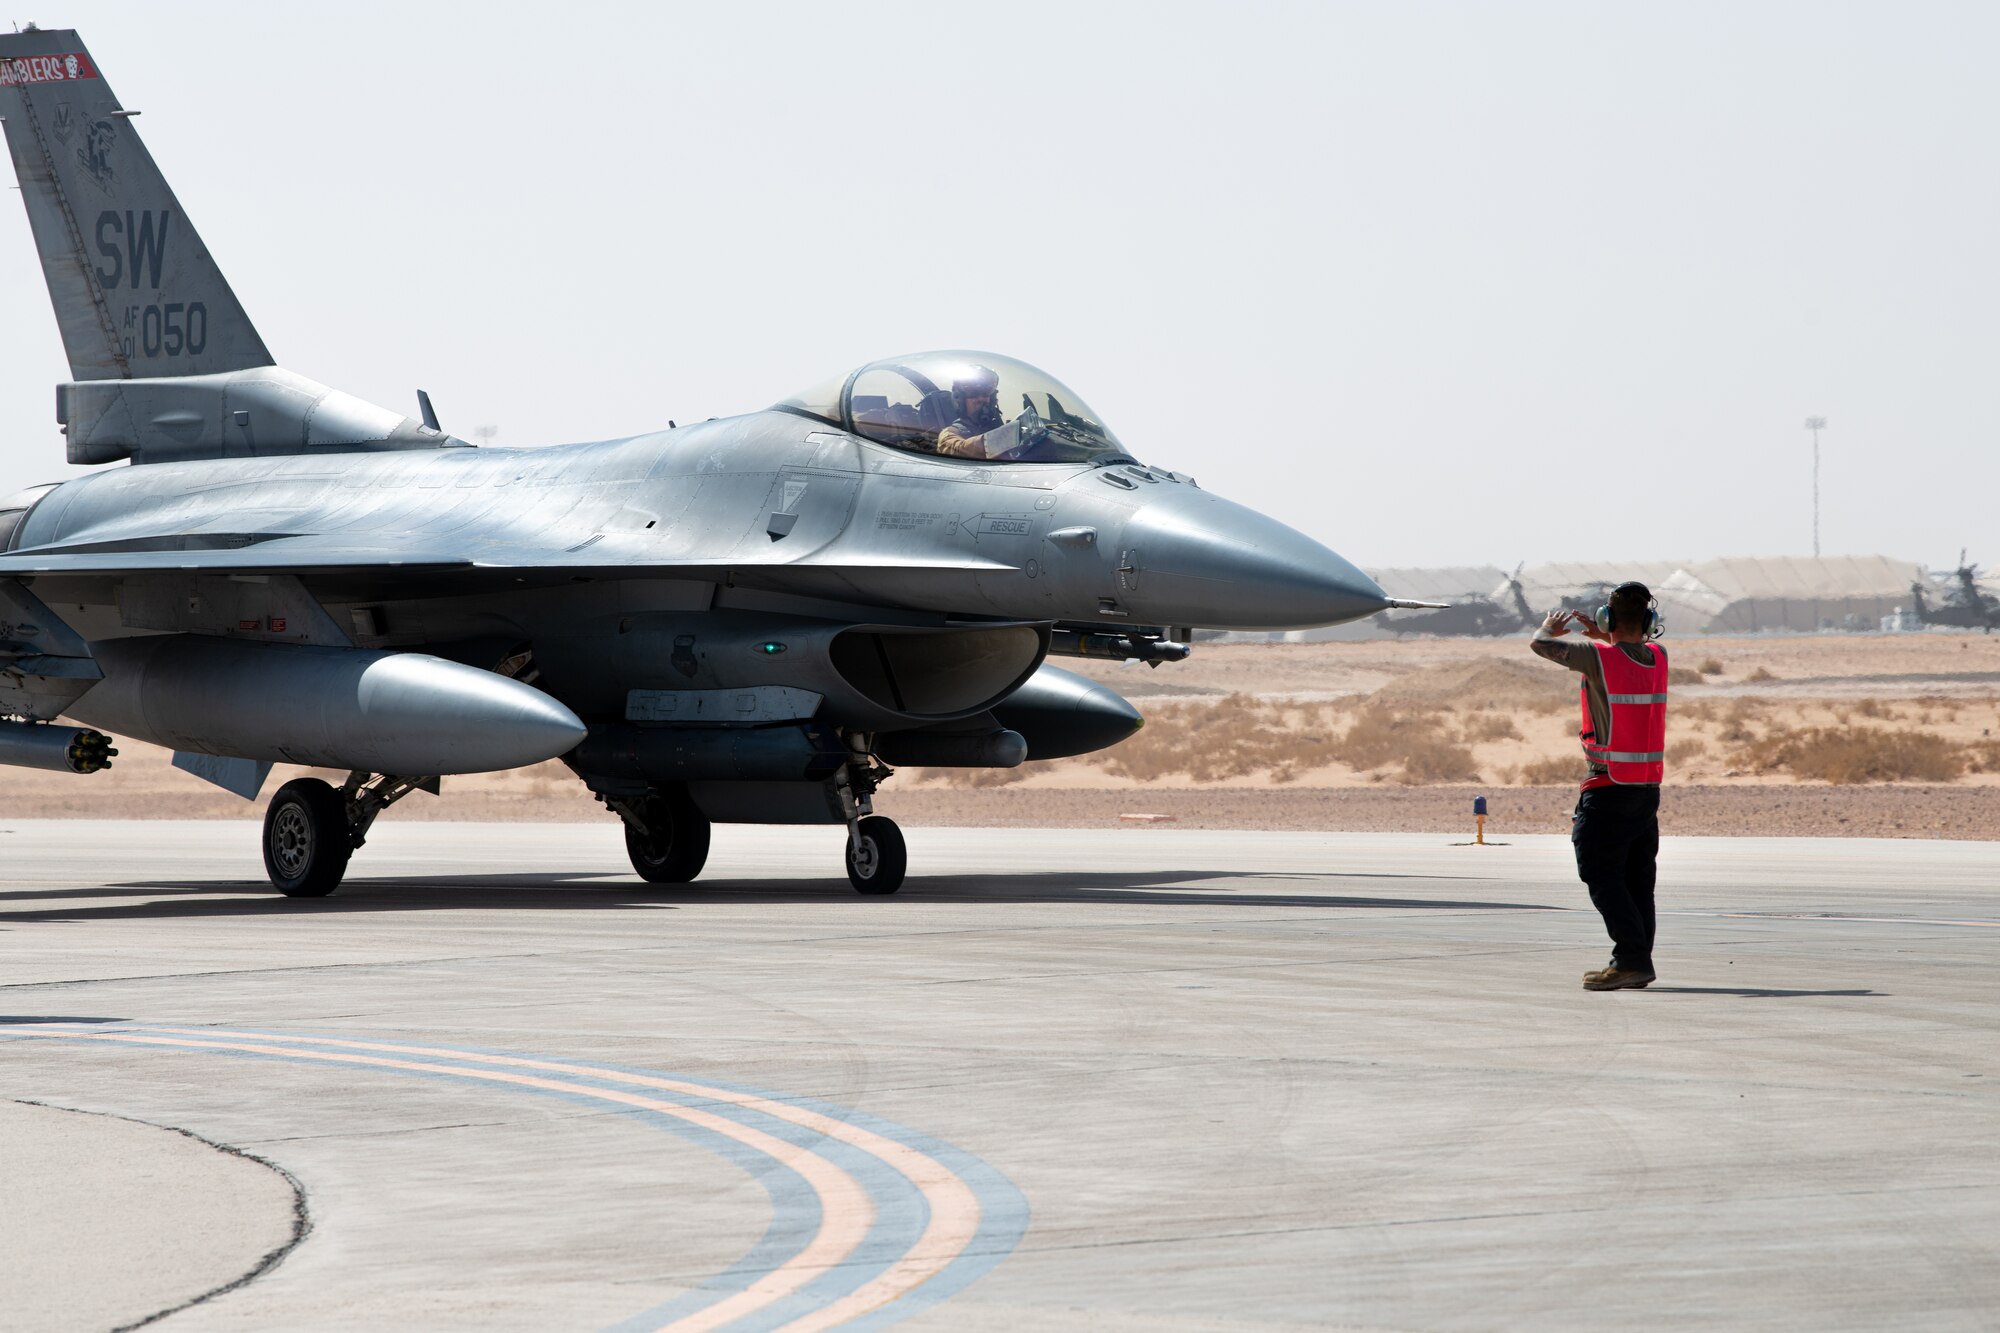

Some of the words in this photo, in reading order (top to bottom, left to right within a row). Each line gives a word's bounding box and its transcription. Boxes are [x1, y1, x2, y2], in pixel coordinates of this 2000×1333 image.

[0, 57, 64, 85] AMBLERS
[95, 210, 169, 289] SW
[123, 306, 139, 329] AF
[142, 302, 207, 358] 050
[990, 520, 1027, 533] RESCUE
